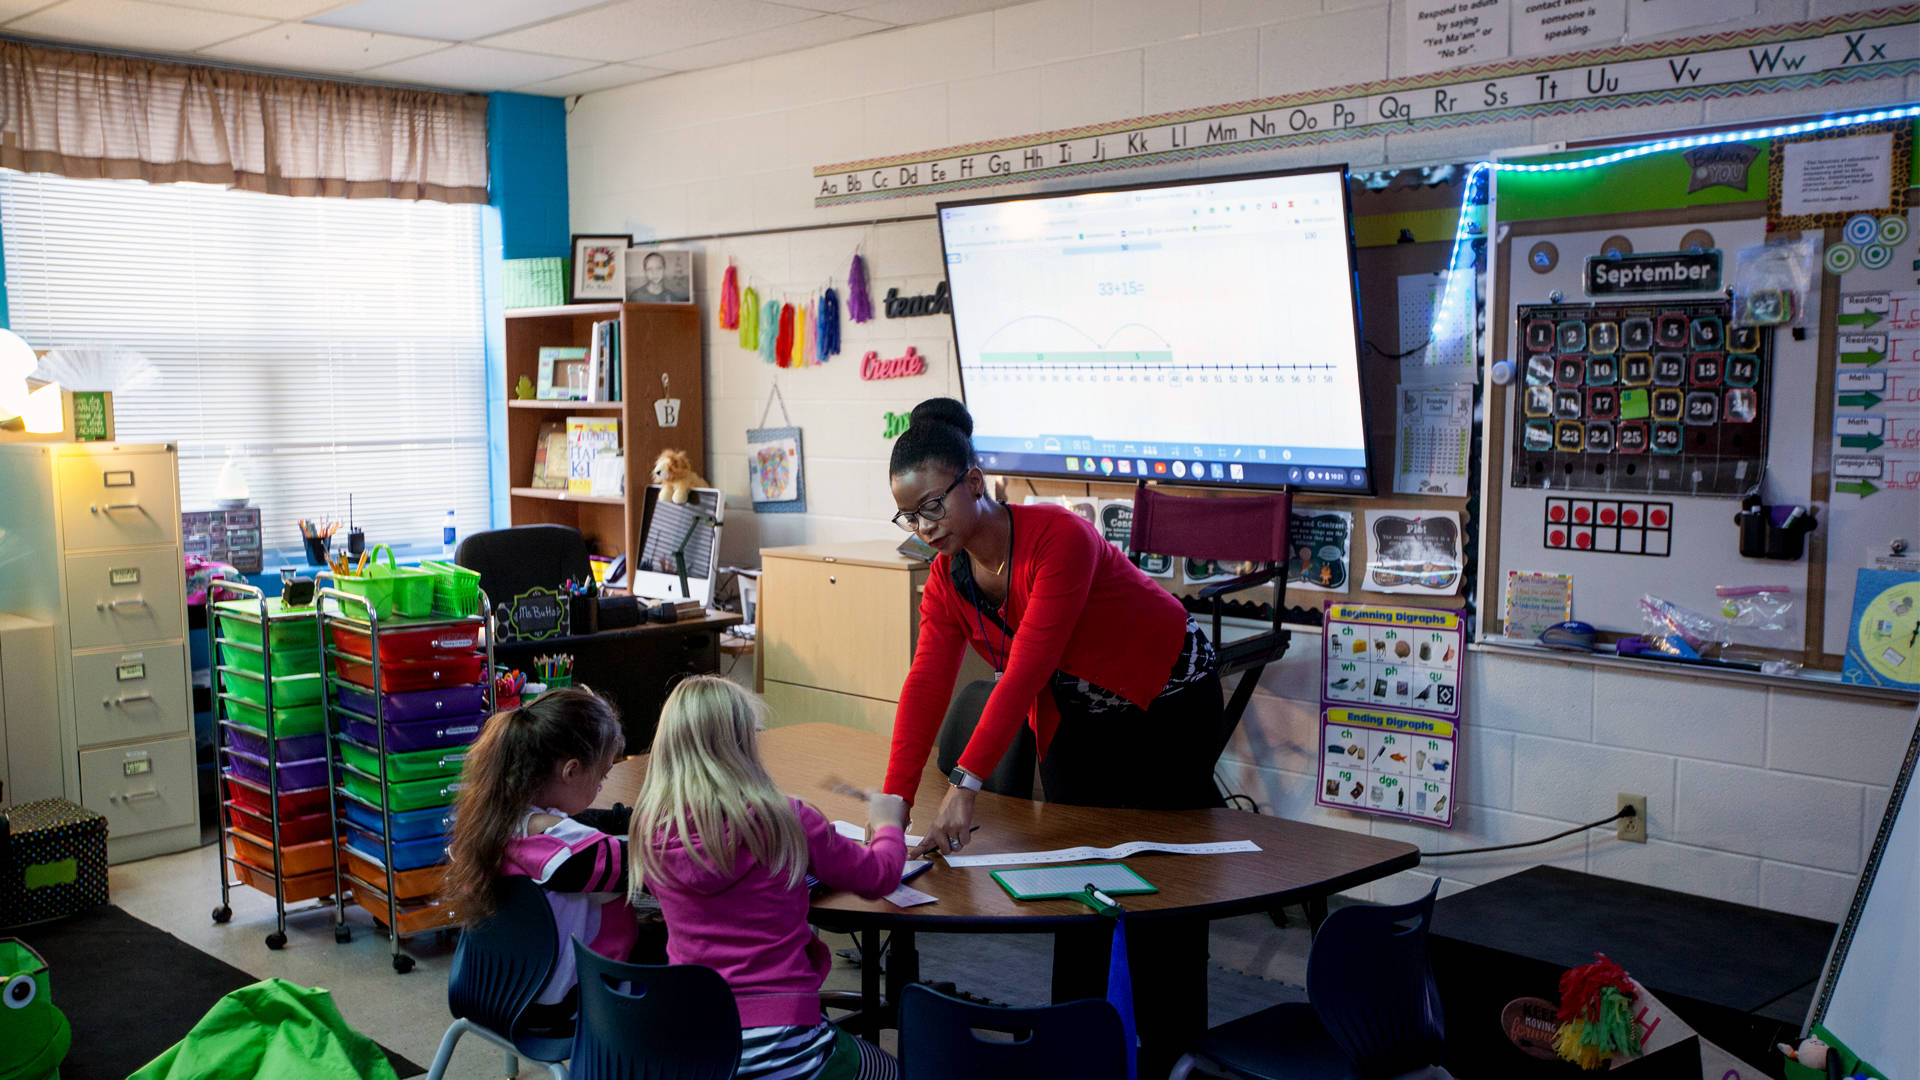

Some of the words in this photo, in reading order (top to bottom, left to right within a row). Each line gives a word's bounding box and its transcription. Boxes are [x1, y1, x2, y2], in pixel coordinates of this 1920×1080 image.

[1418, 4, 1456, 20] Respond
[1459, 4, 1468, 12] to
[1526, 0, 1560, 13] contact
[1437, 22, 1447, 32] by
[1450, 16, 1479, 29] saying
[1541, 10, 1585, 25] someone
[1587, 7, 1596, 16] is
[1482, 28, 1493, 36] or
[1544, 25, 1591, 41] speaking.
[820, 179, 838, 195] Aa
[847, 174, 862, 192] Bb
[872, 171, 888, 189] Cc
[900, 167, 918, 185] Dd
[931, 163, 946, 182] Ee
[960, 158, 973, 178] Ff
[988, 154, 1010, 176] Gg
[1023, 150, 1043, 169] Hh
[1059, 144, 1072, 163] Ii
[1092, 139, 1106, 162] Jj
[1127, 133, 1148, 154] Kk
[1172, 127, 1186, 147] Ll
[1207, 122, 1237, 144] Mm
[1251, 114, 1276, 137] Nn
[1289, 109, 1318, 132] Oo
[1333, 104, 1355, 130] Pp
[1379, 96, 1415, 125] Qq
[1434, 90, 1457, 114] Rr
[1484, 84, 1509, 106] Ss
[1536, 75, 1558, 101] Tt
[1586, 67, 1619, 94] Uu
[1669, 58, 1701, 84] Vv
[1749, 48, 1806, 75] Ww
[1841, 34, 1887, 65] Xx
[1596, 262, 1710, 287] September
[1098, 281, 1144, 297] 33+15=
[1849, 296, 1883, 305] Reading
[1537, 329, 1544, 341] 1
[1567, 330, 1576, 342] 2
[1599, 329, 1608, 343] 3
[1631, 327, 1642, 340] 4
[1668, 324, 1678, 336] 5
[1702, 326, 1712, 339] 6
[1738, 329, 1747, 342] 7
[1845, 335, 1879, 344] Reading
[860, 346, 926, 380] Create
[1565, 366, 1574, 378] 9
[1593, 363, 1610, 376] 10
[1631, 363, 1645, 376] 11
[1661, 362, 1678, 375] 12
[1698, 363, 1715, 376] 13
[1734, 363, 1751, 377] 14
[1849, 374, 1870, 382] Math
[665, 406, 675, 424] B
[1559, 397, 1575, 410] 16
[1595, 397, 1611, 410] 17
[1659, 397, 1676, 410] 19
[1692, 402, 1711, 416] 20
[1733, 399, 1749, 413] 21
[574, 424, 583, 442] 7
[1562, 430, 1579, 444] 23
[1590, 430, 1609, 443] 24
[1623, 431, 1642, 444] 25
[1657, 430, 1676, 443] 26
[571, 460, 590, 477] KI
[1406, 524, 1426, 534] Plot
[1340, 608, 1393, 621] Beginning
[1396, 612, 1446, 625] Digraphs
[1342, 626, 1353, 636] ch
[1385, 630, 1397, 639] sh
[1432, 633, 1442, 642] th
[1341, 662, 1356, 672] wh
[1385, 666, 1398, 677] ph
[1430, 672, 1442, 682] qu
[1347, 713, 1383, 725] Ending
[1386, 717, 1434, 731] Digraphs
[1341, 729, 1352, 739] ch
[1384, 735, 1395, 745] sh
[1428, 740, 1438, 750] th
[1339, 771, 1351, 782] ng
[1379, 775, 1398, 787] dge
[1424, 782, 1439, 792] tch
[1525, 1016, 1557, 1033] MOVING
